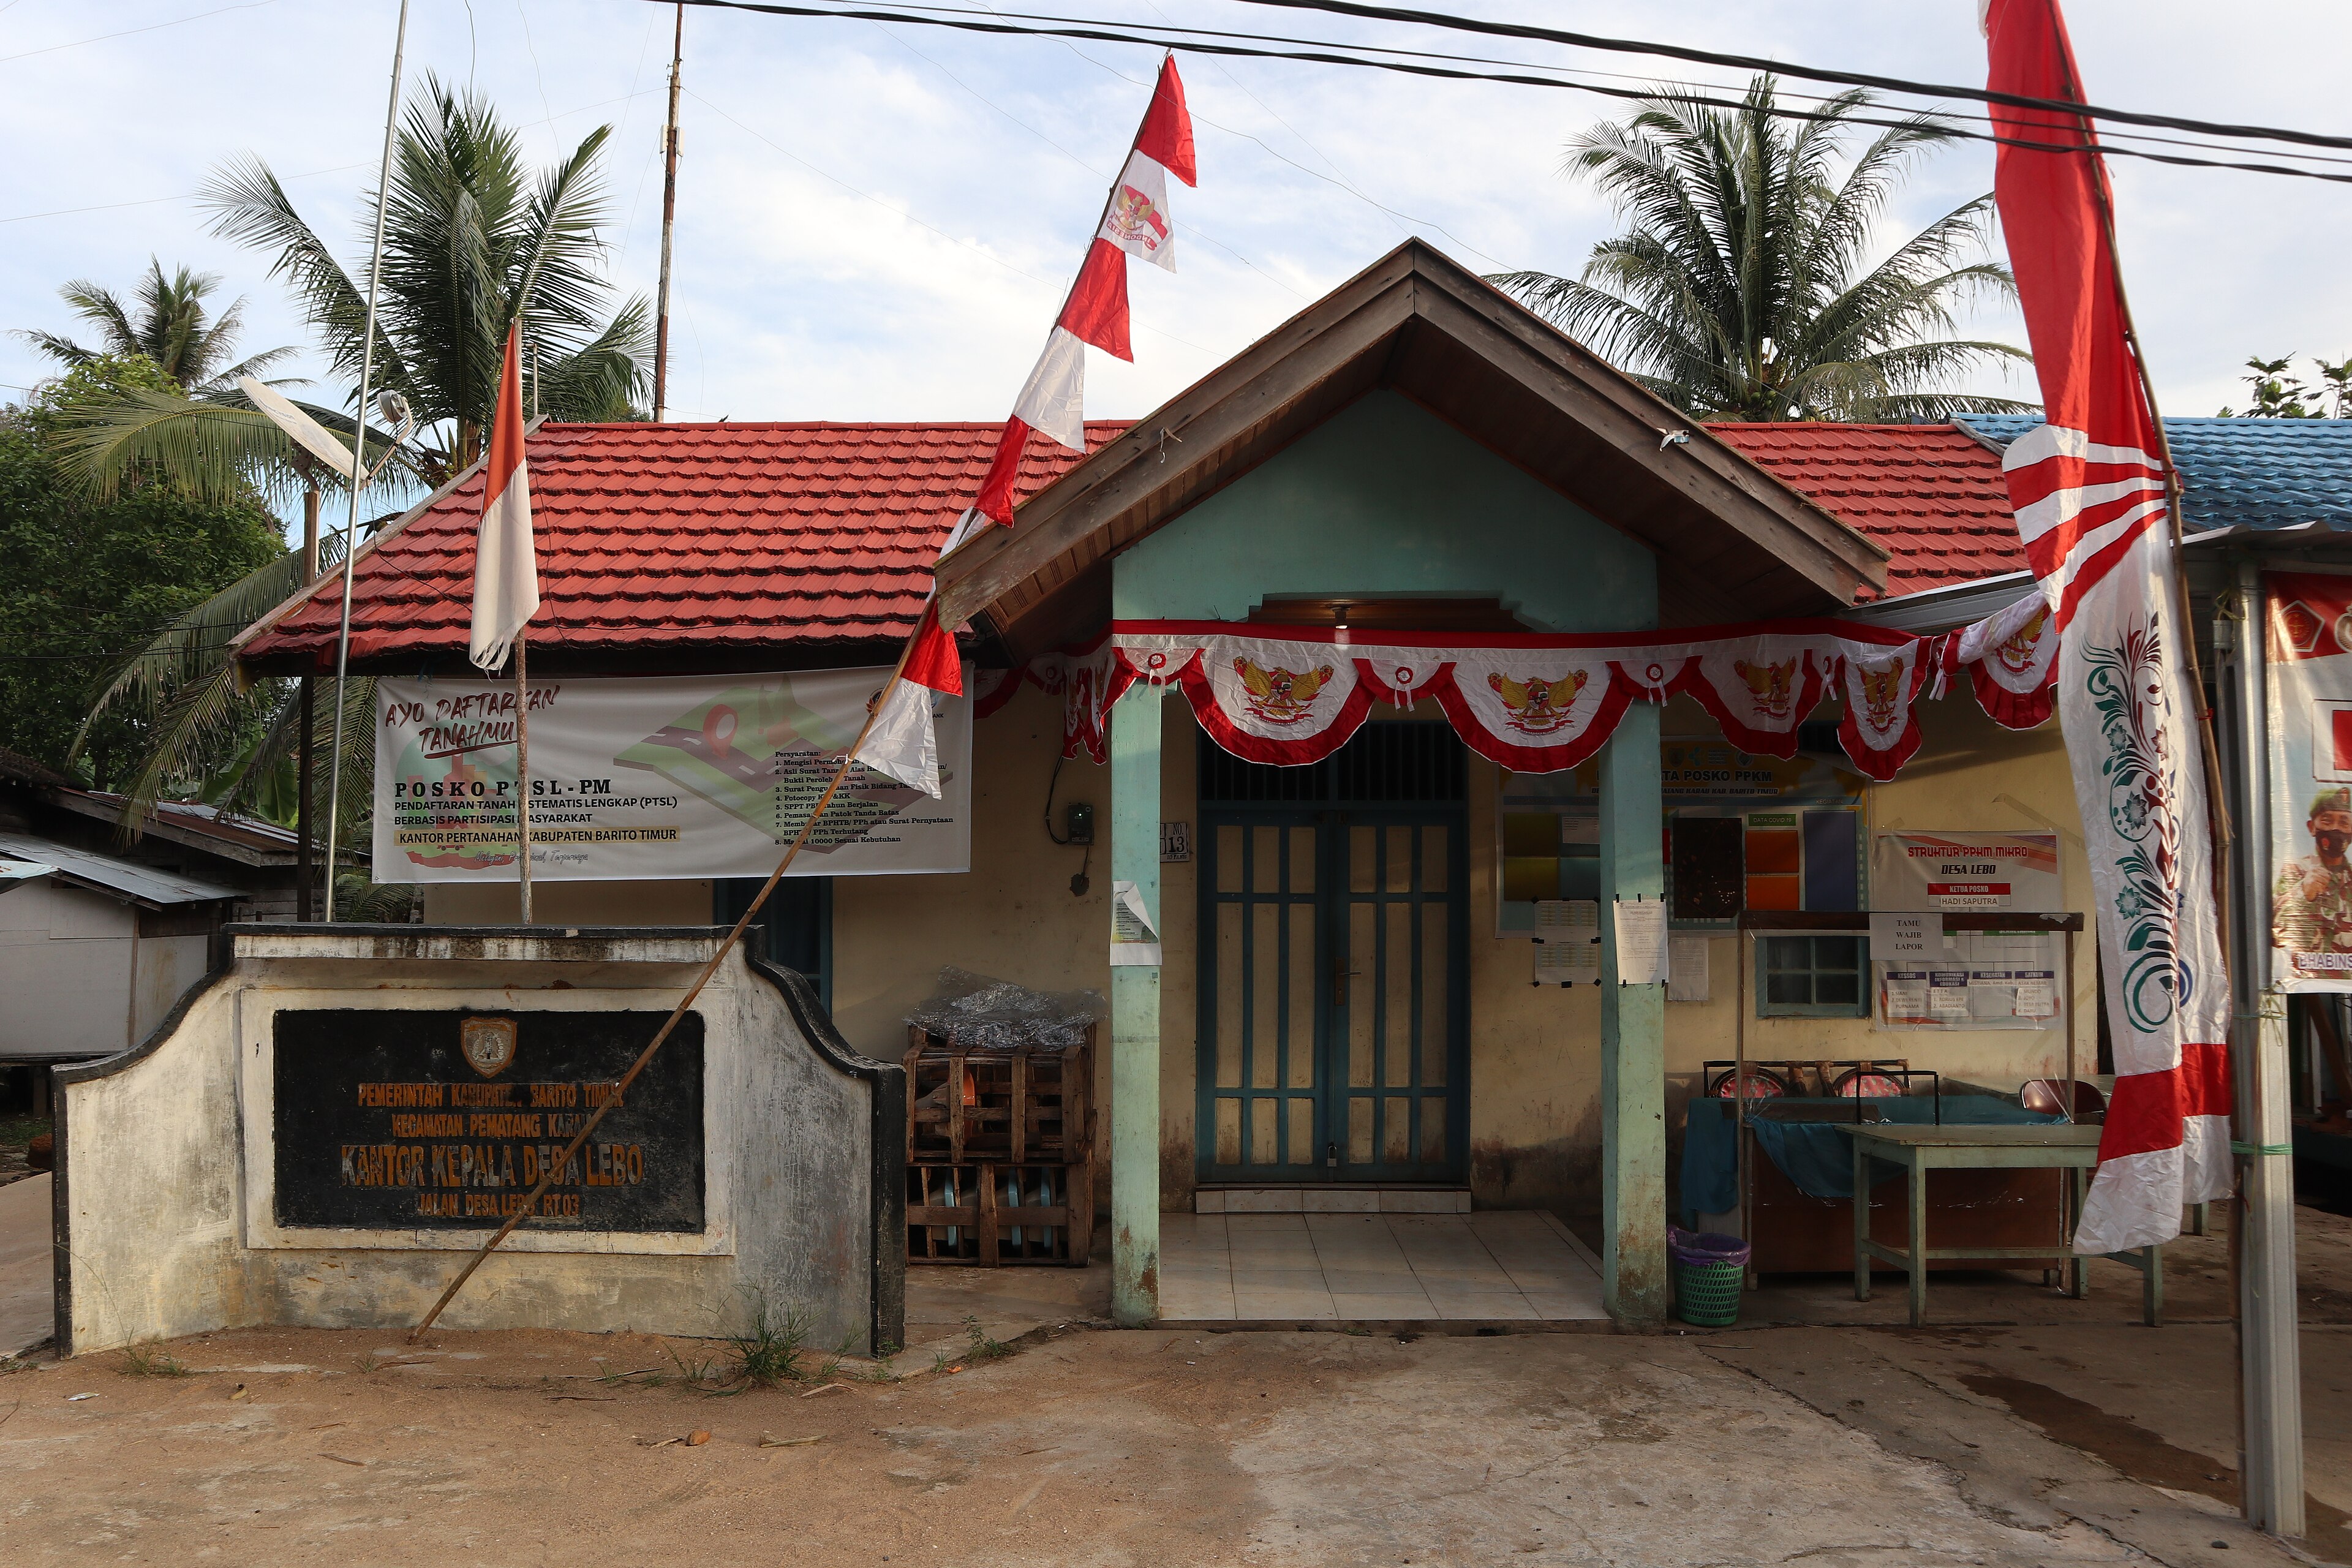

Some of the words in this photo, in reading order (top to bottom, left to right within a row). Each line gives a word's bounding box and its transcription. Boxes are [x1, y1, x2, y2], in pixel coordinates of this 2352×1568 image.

[385, 702, 424, 728] AYO
[419, 720, 515, 752] TANAHMU
[1683, 770, 1731, 782] POSKO
[1735, 771, 1773, 782] PPKM
[394, 801, 474, 810] PENDAFTARAN
[478, 800, 516, 810] TANAH
[527, 799, 582, 809] STEMATIS
[585, 798, 638, 808] LENGKAP
[639, 796, 678, 809] (PTSL)
[394, 815, 445, 825] BERBASIS
[448, 814, 515, 824] PARTISIPASI
[518, 813, 593, 823] ASYARAKAT
[399, 832, 444, 843] KANTOR
[595, 830, 637, 841] BARITO
[639, 829, 677, 840] TIMUR
[1173, 823, 1183, 835] NO.
[1169, 837, 1185, 853] 13
[1995, 846, 2029, 858] MIKRO
[1940, 864, 1967, 875] DESA
[1970, 864, 1997, 875] LEBO
[358, 1083, 443, 1107] PEMERINTAH
[530, 1083, 578, 1107] BARITO
[392, 1114, 464, 1137] KECAMATAN
[470, 1114, 541, 1138] PEMATANG
[341, 1145, 427, 1187] KANTOR
[431, 1144, 518, 1188] KEPALA
[523, 1145, 581, 1187] DESA
[585, 1144, 644, 1187] LEBO
[417, 1193, 459, 1216] JALAN
[465, 1194, 500, 1216] DESA
